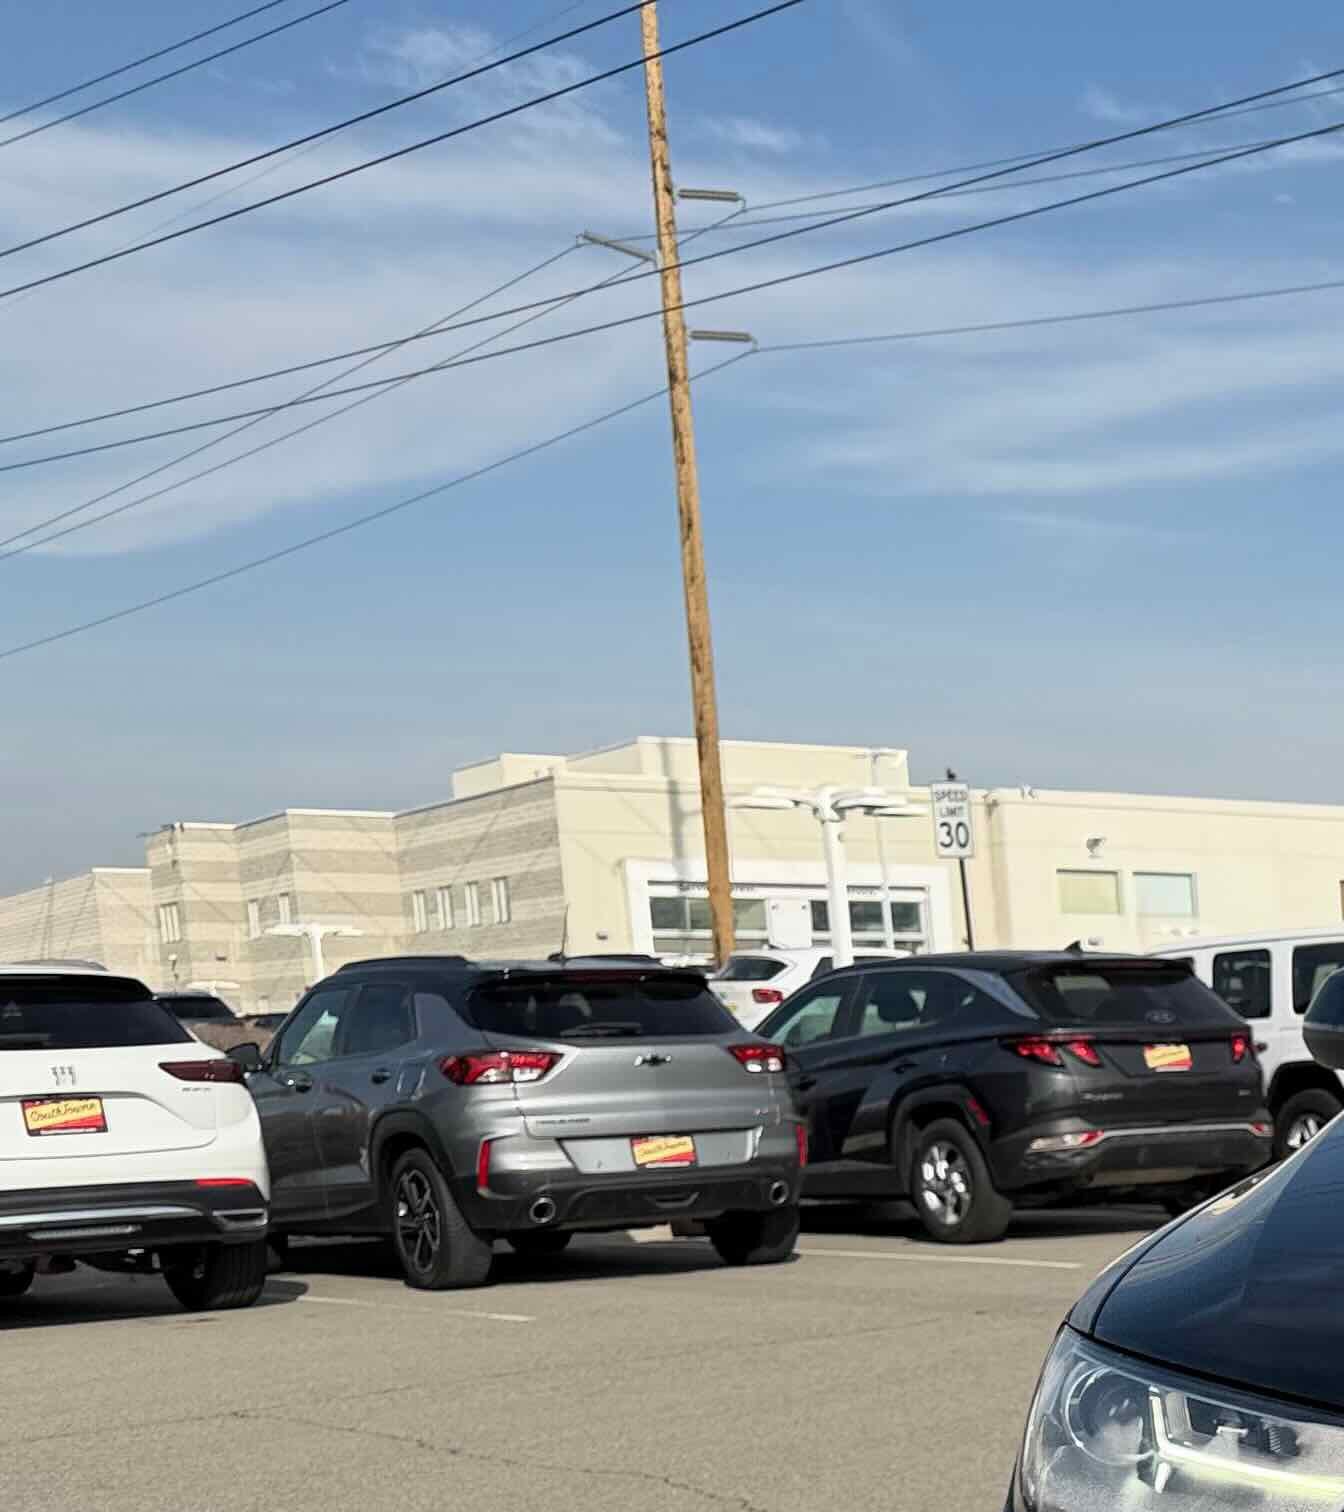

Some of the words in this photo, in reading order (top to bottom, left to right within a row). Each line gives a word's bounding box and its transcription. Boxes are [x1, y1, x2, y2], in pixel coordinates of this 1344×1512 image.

[935, 790, 968, 801] SPEED
[941, 805, 964, 817] LIMIT
[940, 821, 969, 848] 30
